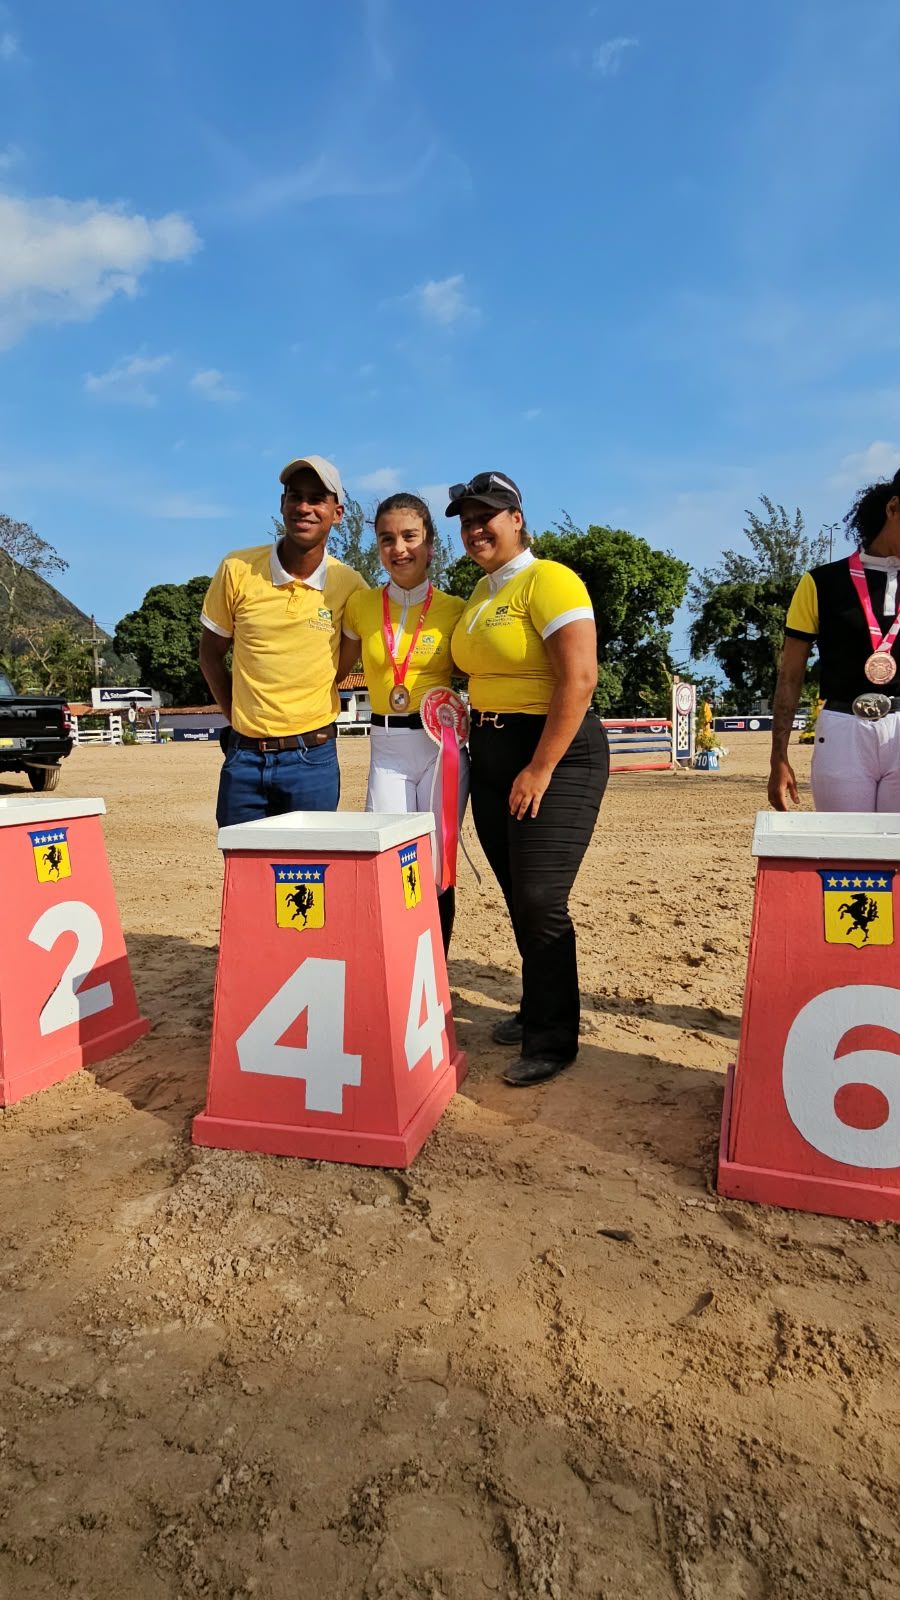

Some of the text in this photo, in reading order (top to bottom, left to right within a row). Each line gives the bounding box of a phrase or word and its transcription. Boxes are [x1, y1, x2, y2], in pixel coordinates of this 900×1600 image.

[698, 755, 707, 767] 10
[709, 755, 718, 767] 10
[28, 900, 114, 1036] 2
[236, 957, 362, 1114] 4
[404, 928, 445, 1072] 4
[782, 984, 900, 1169] 6
